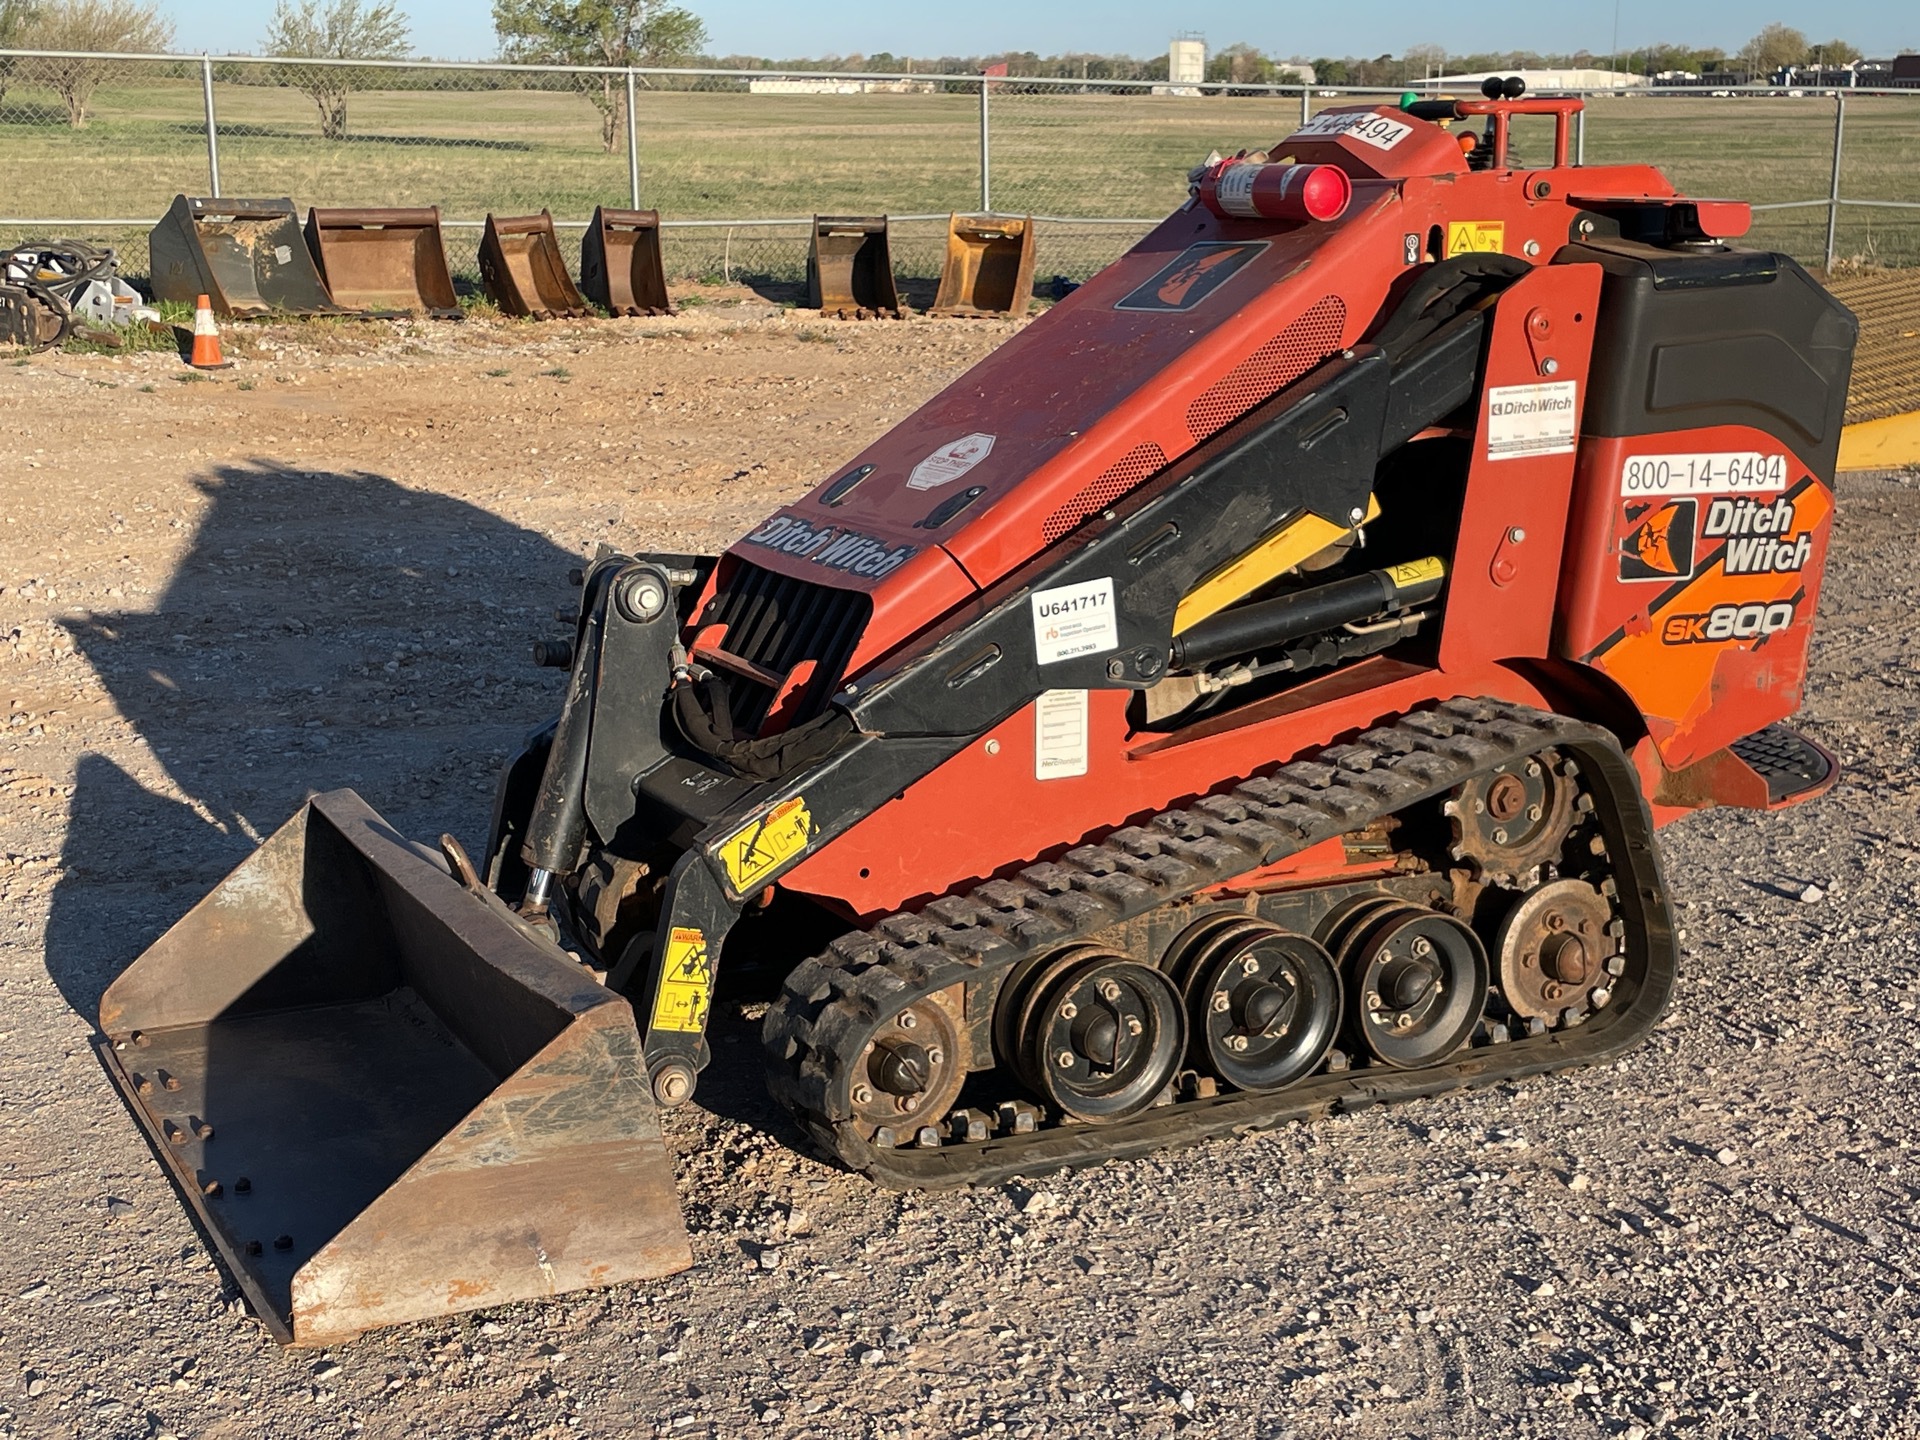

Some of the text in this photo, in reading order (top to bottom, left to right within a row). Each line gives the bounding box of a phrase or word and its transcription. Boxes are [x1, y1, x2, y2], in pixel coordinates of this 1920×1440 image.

[1503, 396, 1572, 415] Ditch Witch
[1627, 456, 1782, 491] 800-14-6494
[1704, 497, 1794, 536] Ditch
[749, 515, 906, 577] Ditch Witch
[1725, 535, 1812, 574] Witch
[1039, 592, 1107, 618] U641717
[1664, 603, 1794, 642] SK800
[1045, 626, 1059, 641] rb
